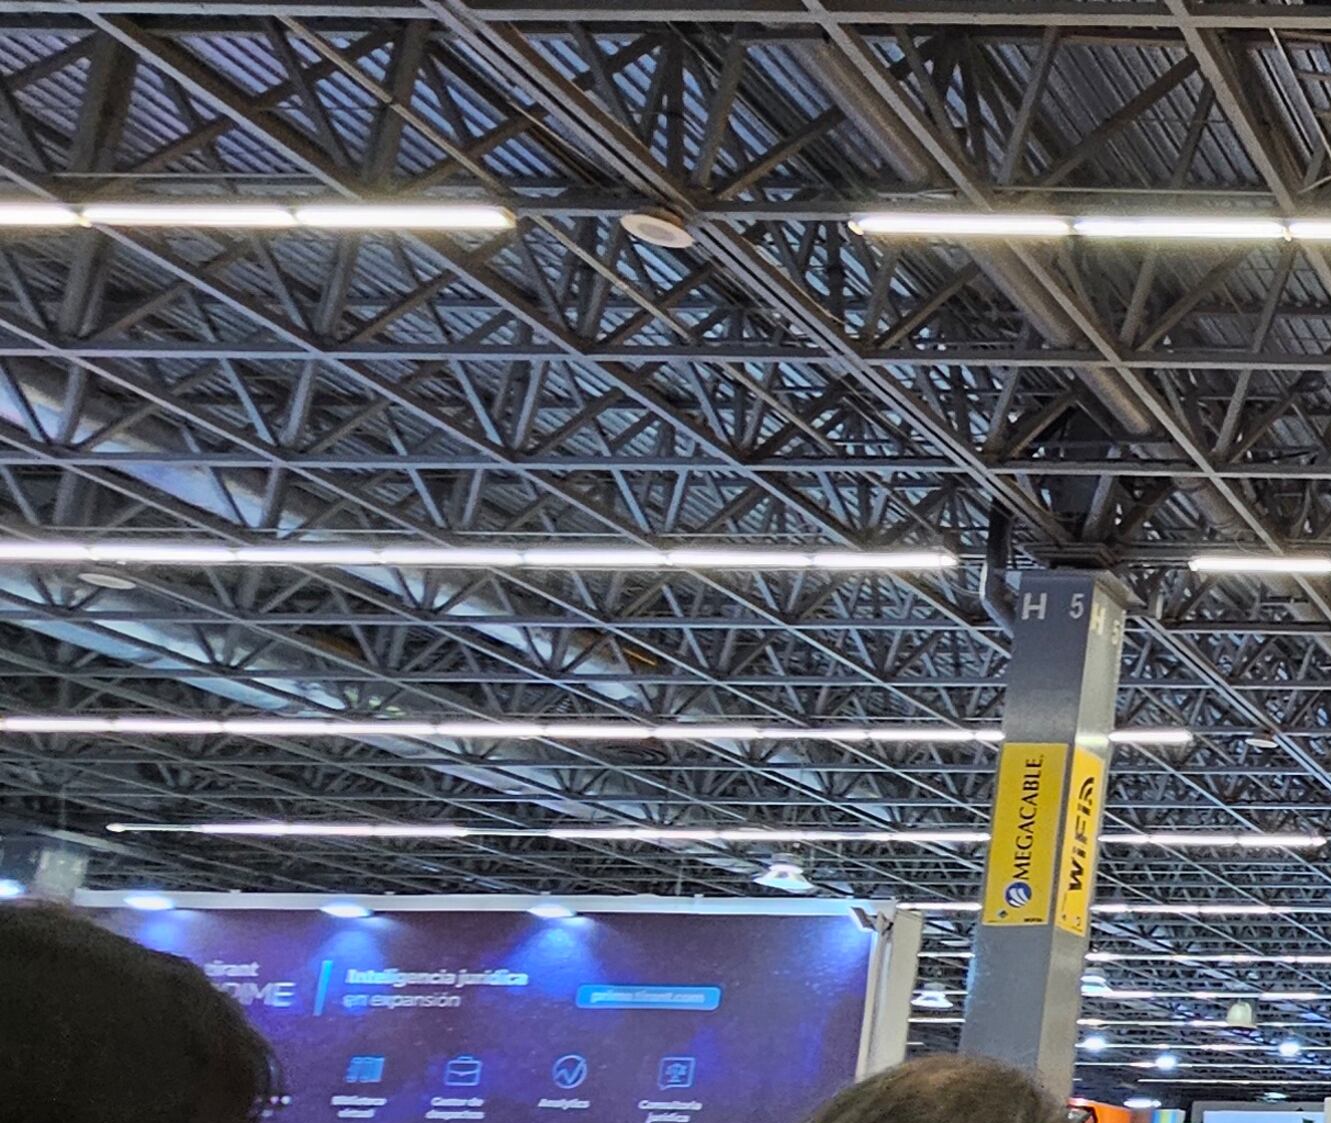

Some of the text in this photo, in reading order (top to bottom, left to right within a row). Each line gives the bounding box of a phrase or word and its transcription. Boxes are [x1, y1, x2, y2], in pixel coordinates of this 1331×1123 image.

[1021, 592, 1084, 620] H 5
[1012, 758, 1043, 880] MEGACABLE
[345, 969, 456, 988] Inteligencia
[370, 991, 461, 1009] expansión
